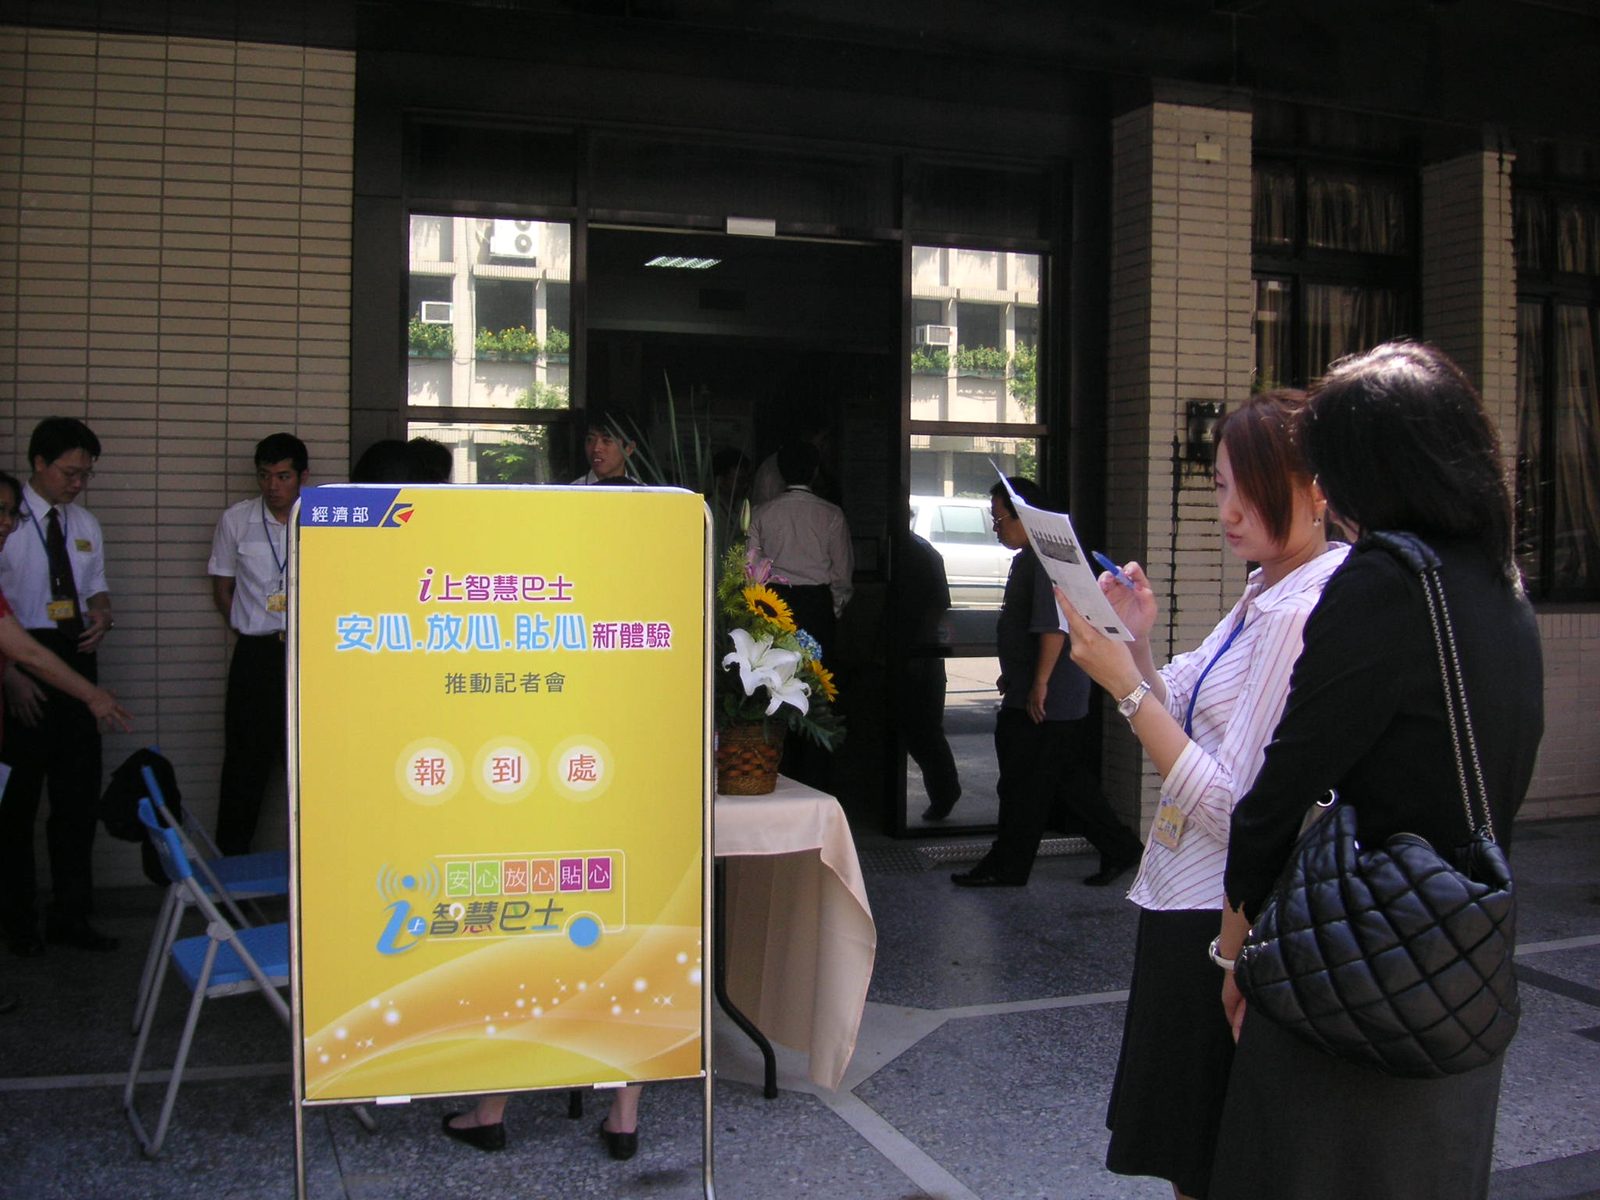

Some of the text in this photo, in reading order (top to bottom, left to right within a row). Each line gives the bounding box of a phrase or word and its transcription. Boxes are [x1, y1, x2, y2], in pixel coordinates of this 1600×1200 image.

[311, 505, 369, 523] 經濟部
[592, 622, 672, 649] 新體驗
[445, 671, 566, 694] 推動記者會
